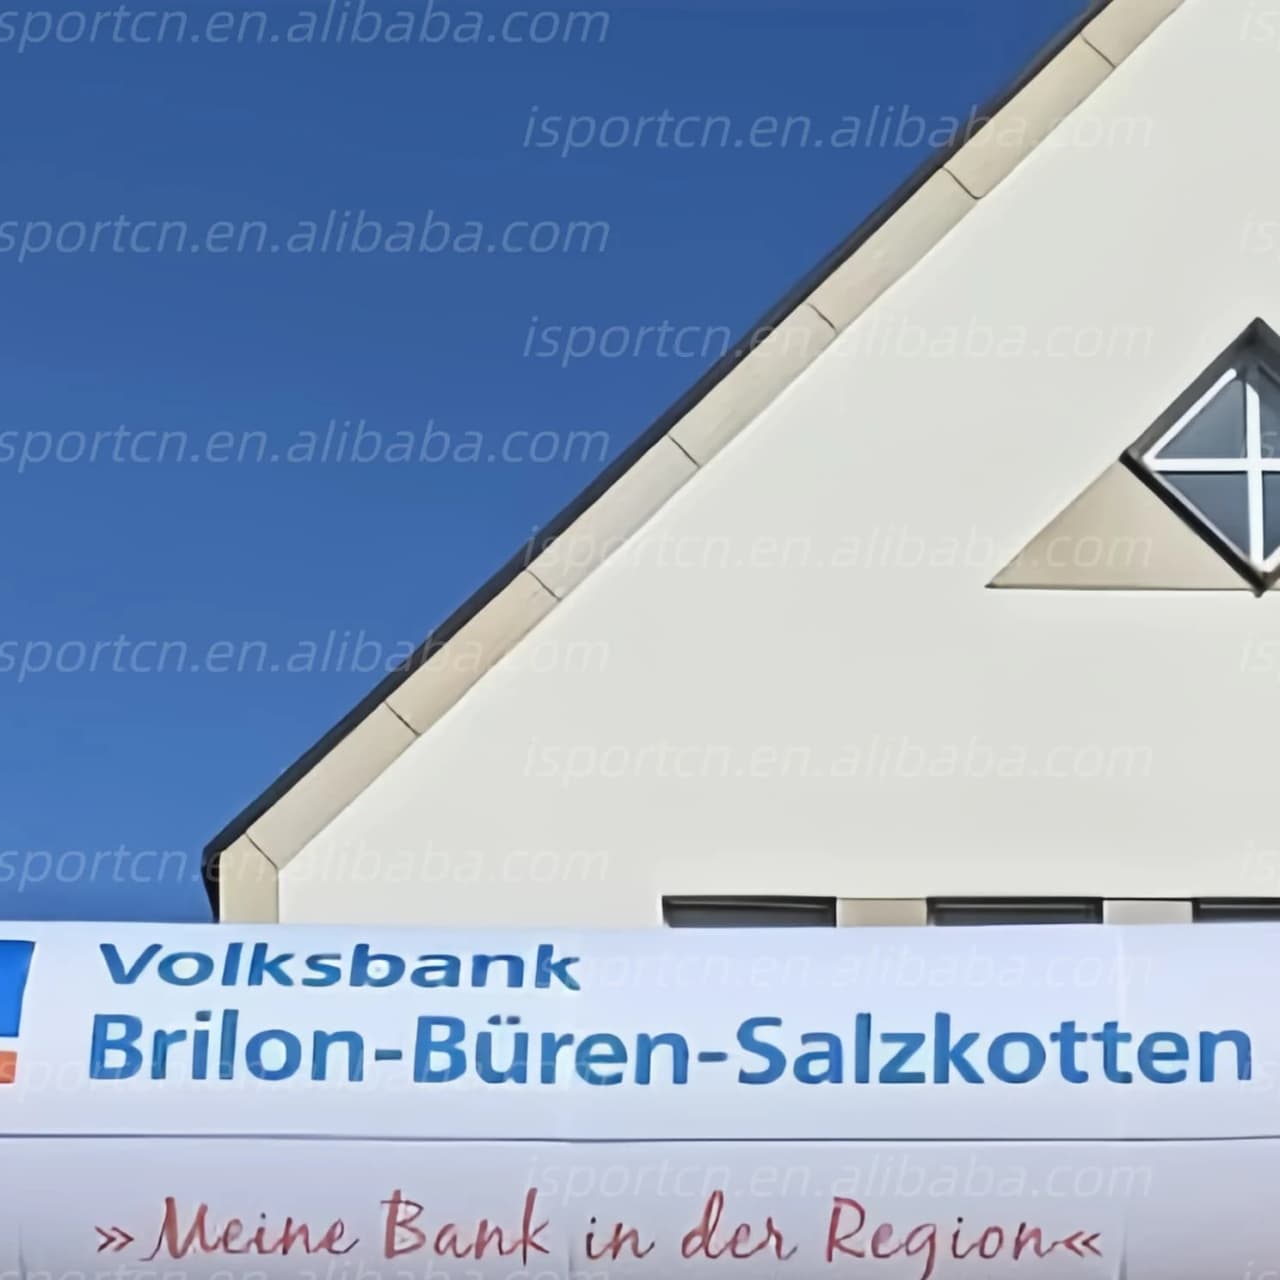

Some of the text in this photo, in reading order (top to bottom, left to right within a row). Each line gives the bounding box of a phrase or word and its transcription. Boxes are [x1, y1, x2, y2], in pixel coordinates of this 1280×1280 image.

[98, 941, 581, 991] Volksbank
[87, 1008, 1253, 1086] Brilon-Büren-Salzkotten
[380, 1187, 551, 1267] Bank
[584, 1215, 656, 1263] in
[680, 1189, 799, 1261] der
